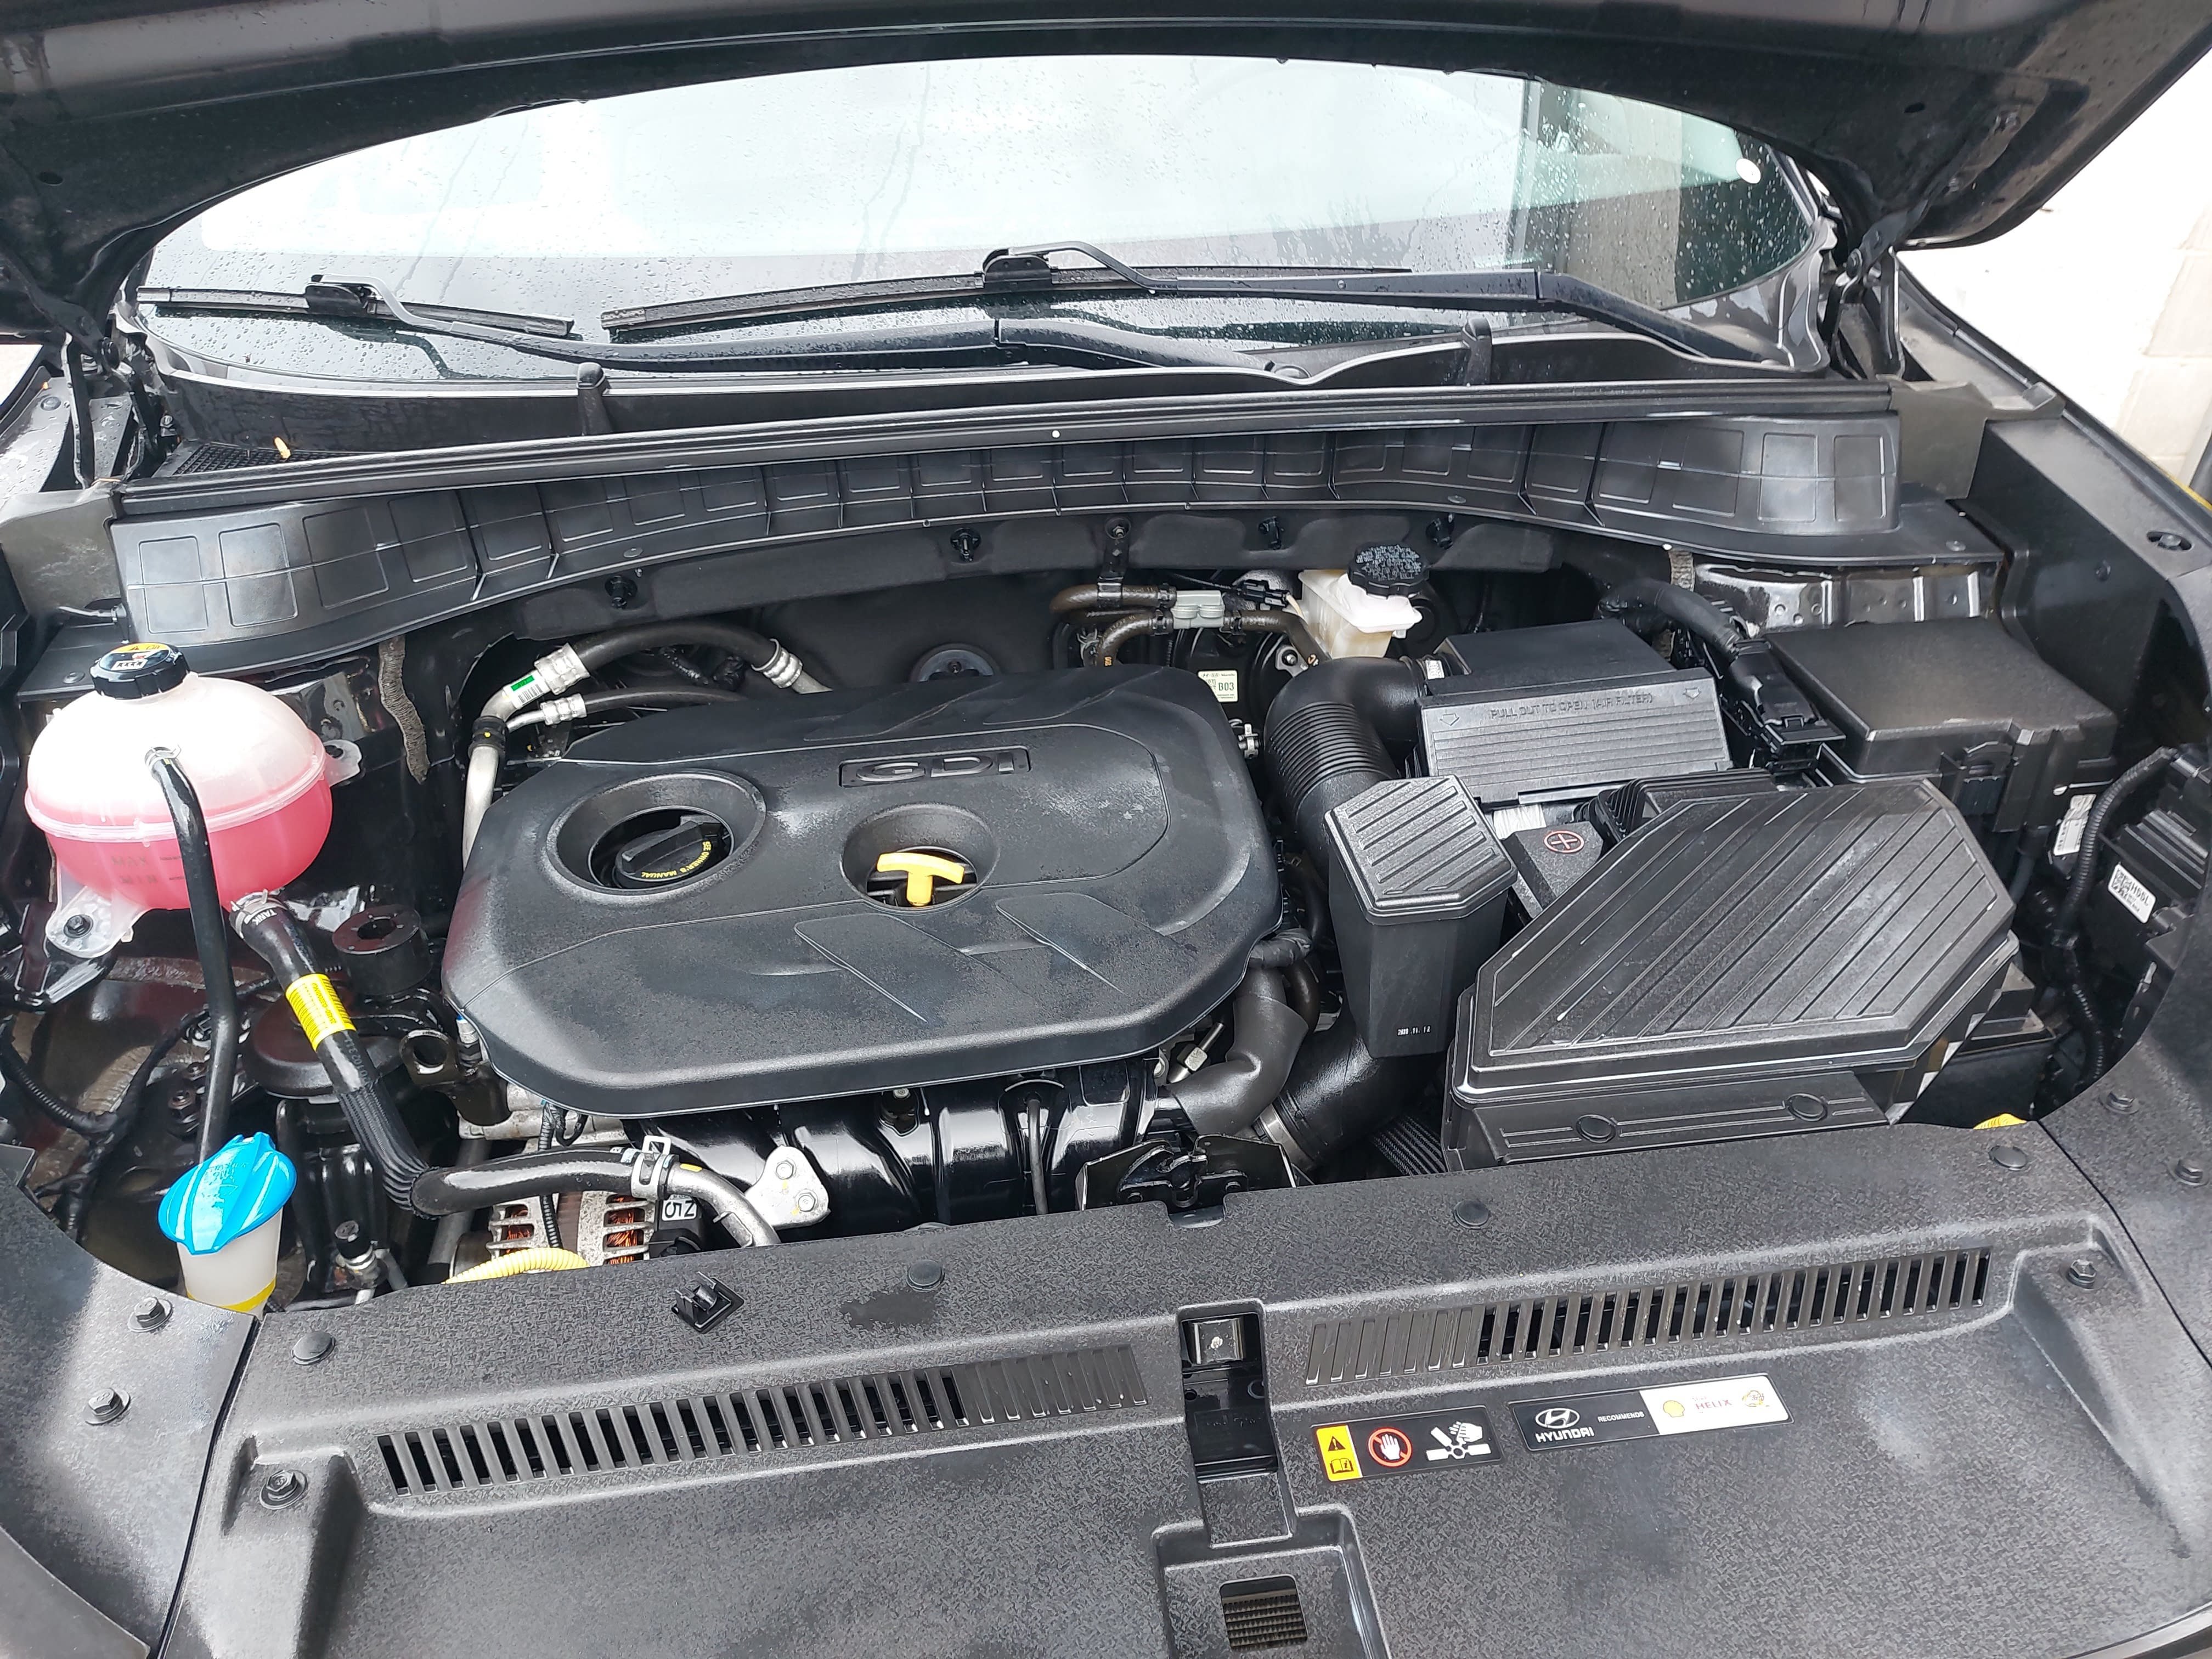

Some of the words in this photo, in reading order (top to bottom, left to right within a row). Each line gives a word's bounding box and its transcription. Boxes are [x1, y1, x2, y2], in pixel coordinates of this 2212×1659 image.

[1218, 682, 1234, 691] B03
[1490, 708, 1518, 719] PULL
[856, 752, 1014, 782] GDI
[702, 841, 712, 851] SEE
[679, 851, 709, 873] OWNER'S
[641, 870, 677, 878] MANUAL
[252, 909, 278, 926] TANK
[1696, 1400, 1732, 1409] HELIX
[1598, 1412, 1645, 1422] RECOMMENDS
[1536, 1427, 1595, 1442] HYUNDAI
